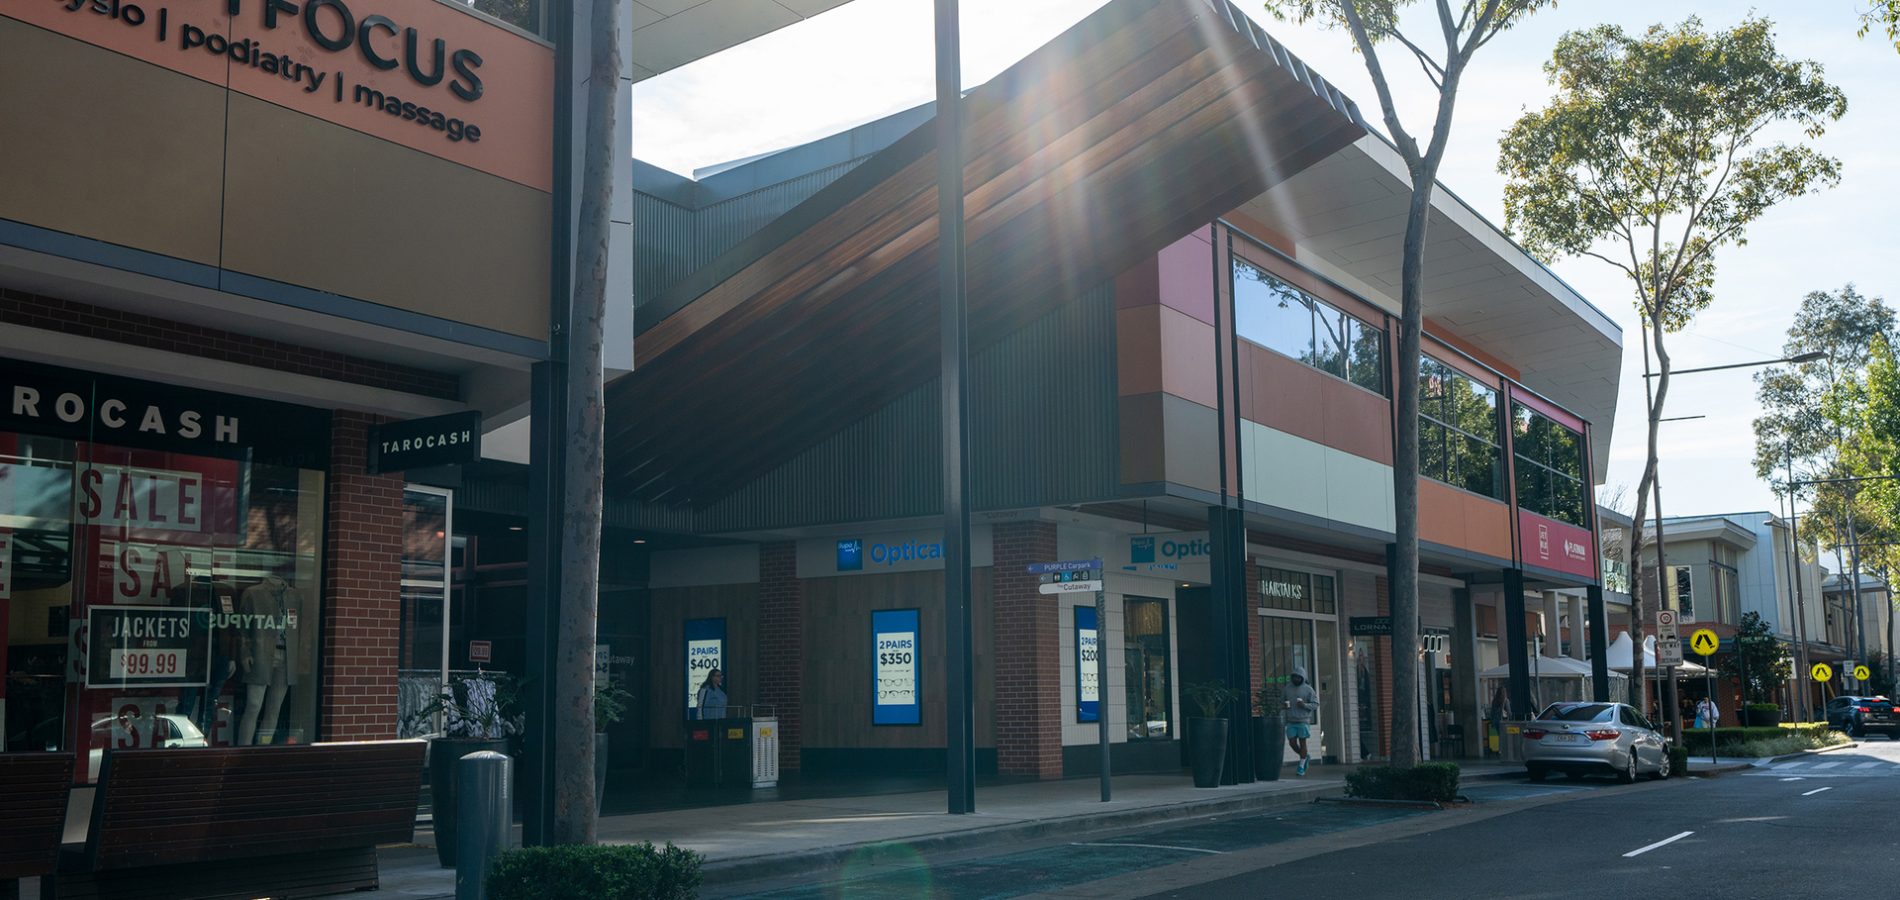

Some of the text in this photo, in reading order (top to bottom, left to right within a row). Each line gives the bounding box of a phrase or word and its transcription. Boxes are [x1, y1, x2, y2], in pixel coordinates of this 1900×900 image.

[228, 0, 485, 102] FOCUS
[182, 23, 327, 93] podiatry
[354, 82, 482, 143] massage
[12, 385, 239, 444] ROCASH
[382, 430, 471, 454] TAROCASH
[79, 468, 198, 525] SALE
[112, 617, 189, 639] JACKETS
[691, 646, 719, 656] 2 PAIRS
[879, 639, 913, 650] 2 PAIRS
[1086, 637, 1098, 645] PAIR
[121, 653, 177, 675] $99.99
[690, 658, 720, 671] $400
[880, 651, 912, 667] $350
